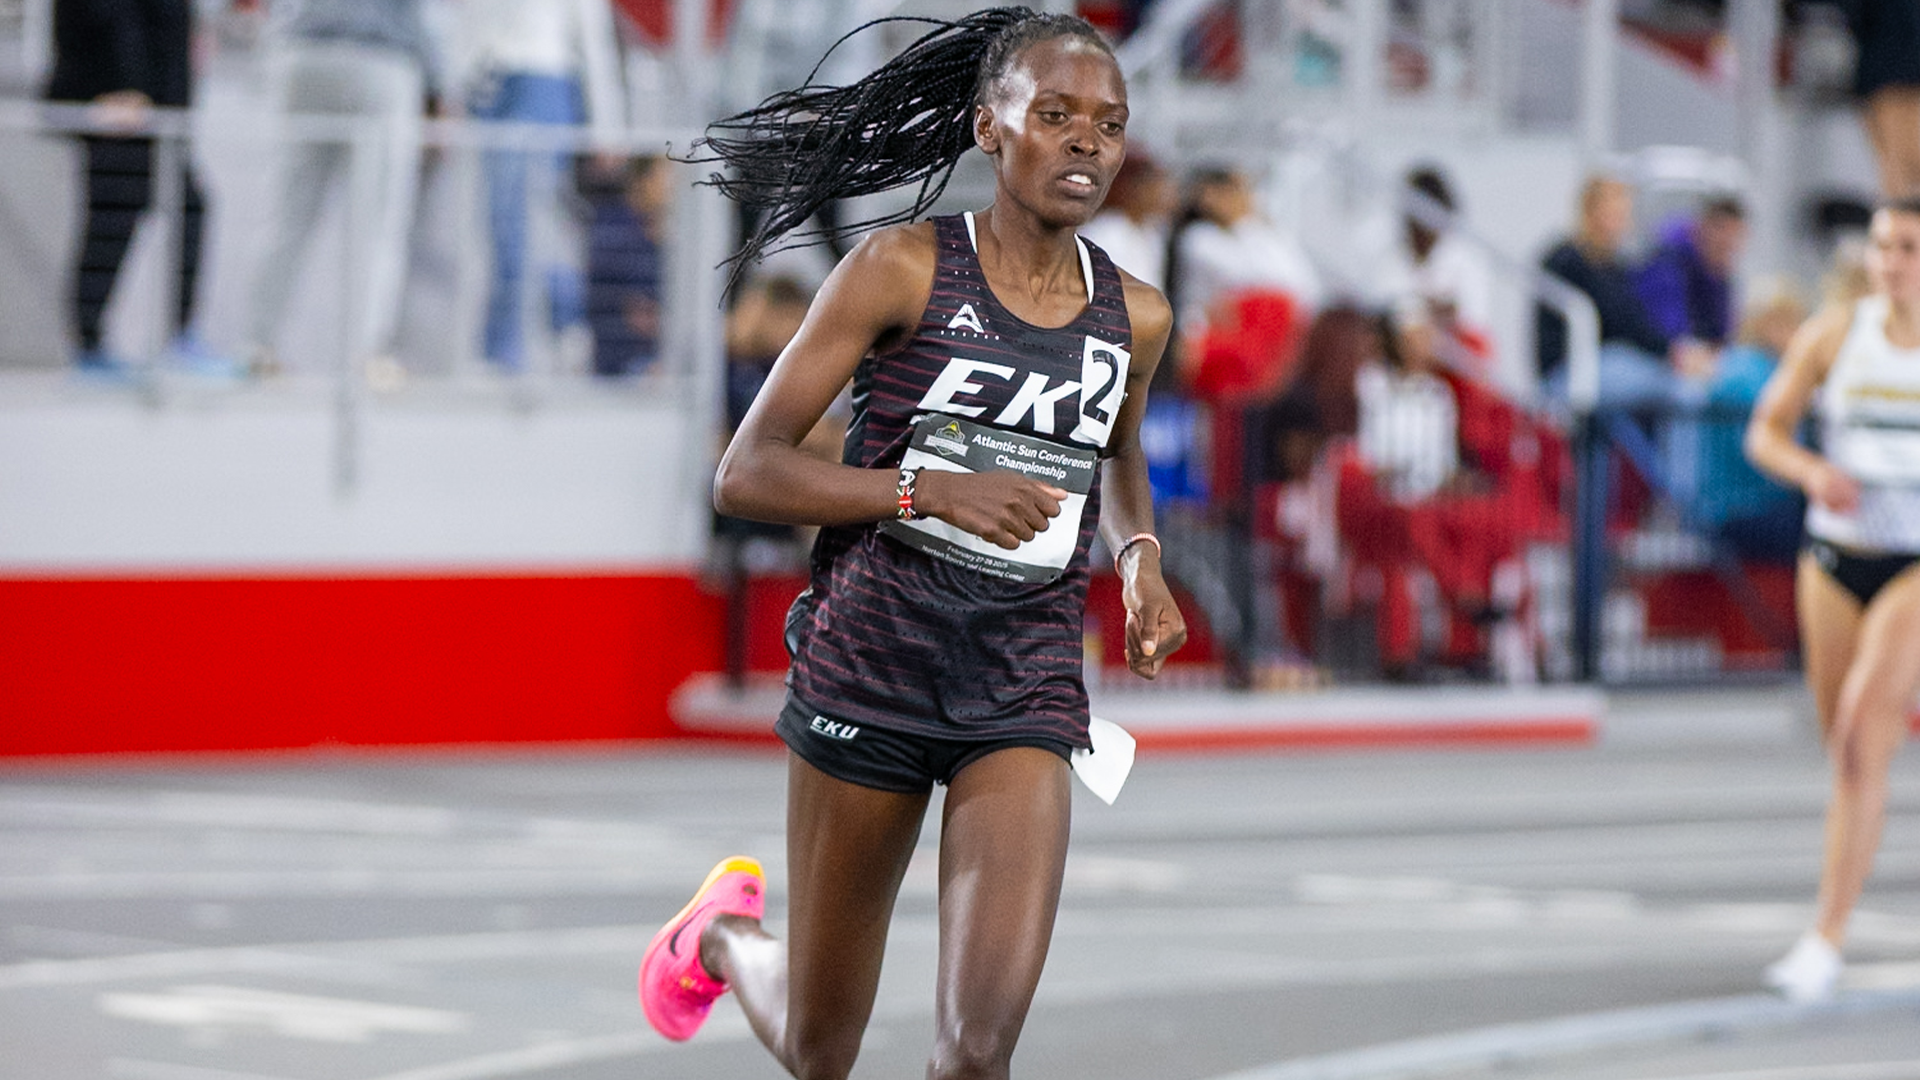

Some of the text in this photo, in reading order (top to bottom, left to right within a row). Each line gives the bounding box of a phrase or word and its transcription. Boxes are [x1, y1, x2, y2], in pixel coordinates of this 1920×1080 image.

[917, 357, 1099, 443] EK
[1082, 349, 1119, 426] 2
[972, 434, 1016, 454] Atlantic
[1017, 444, 1038, 459] Sun
[1038, 449, 1093, 470] Conference
[995, 455, 1067, 480] Championship
[947, 545, 976, 561] February
[979, 565, 1004, 577] Learning
[1005, 571, 1025, 581] Center
[810, 715, 860, 740] EKU
